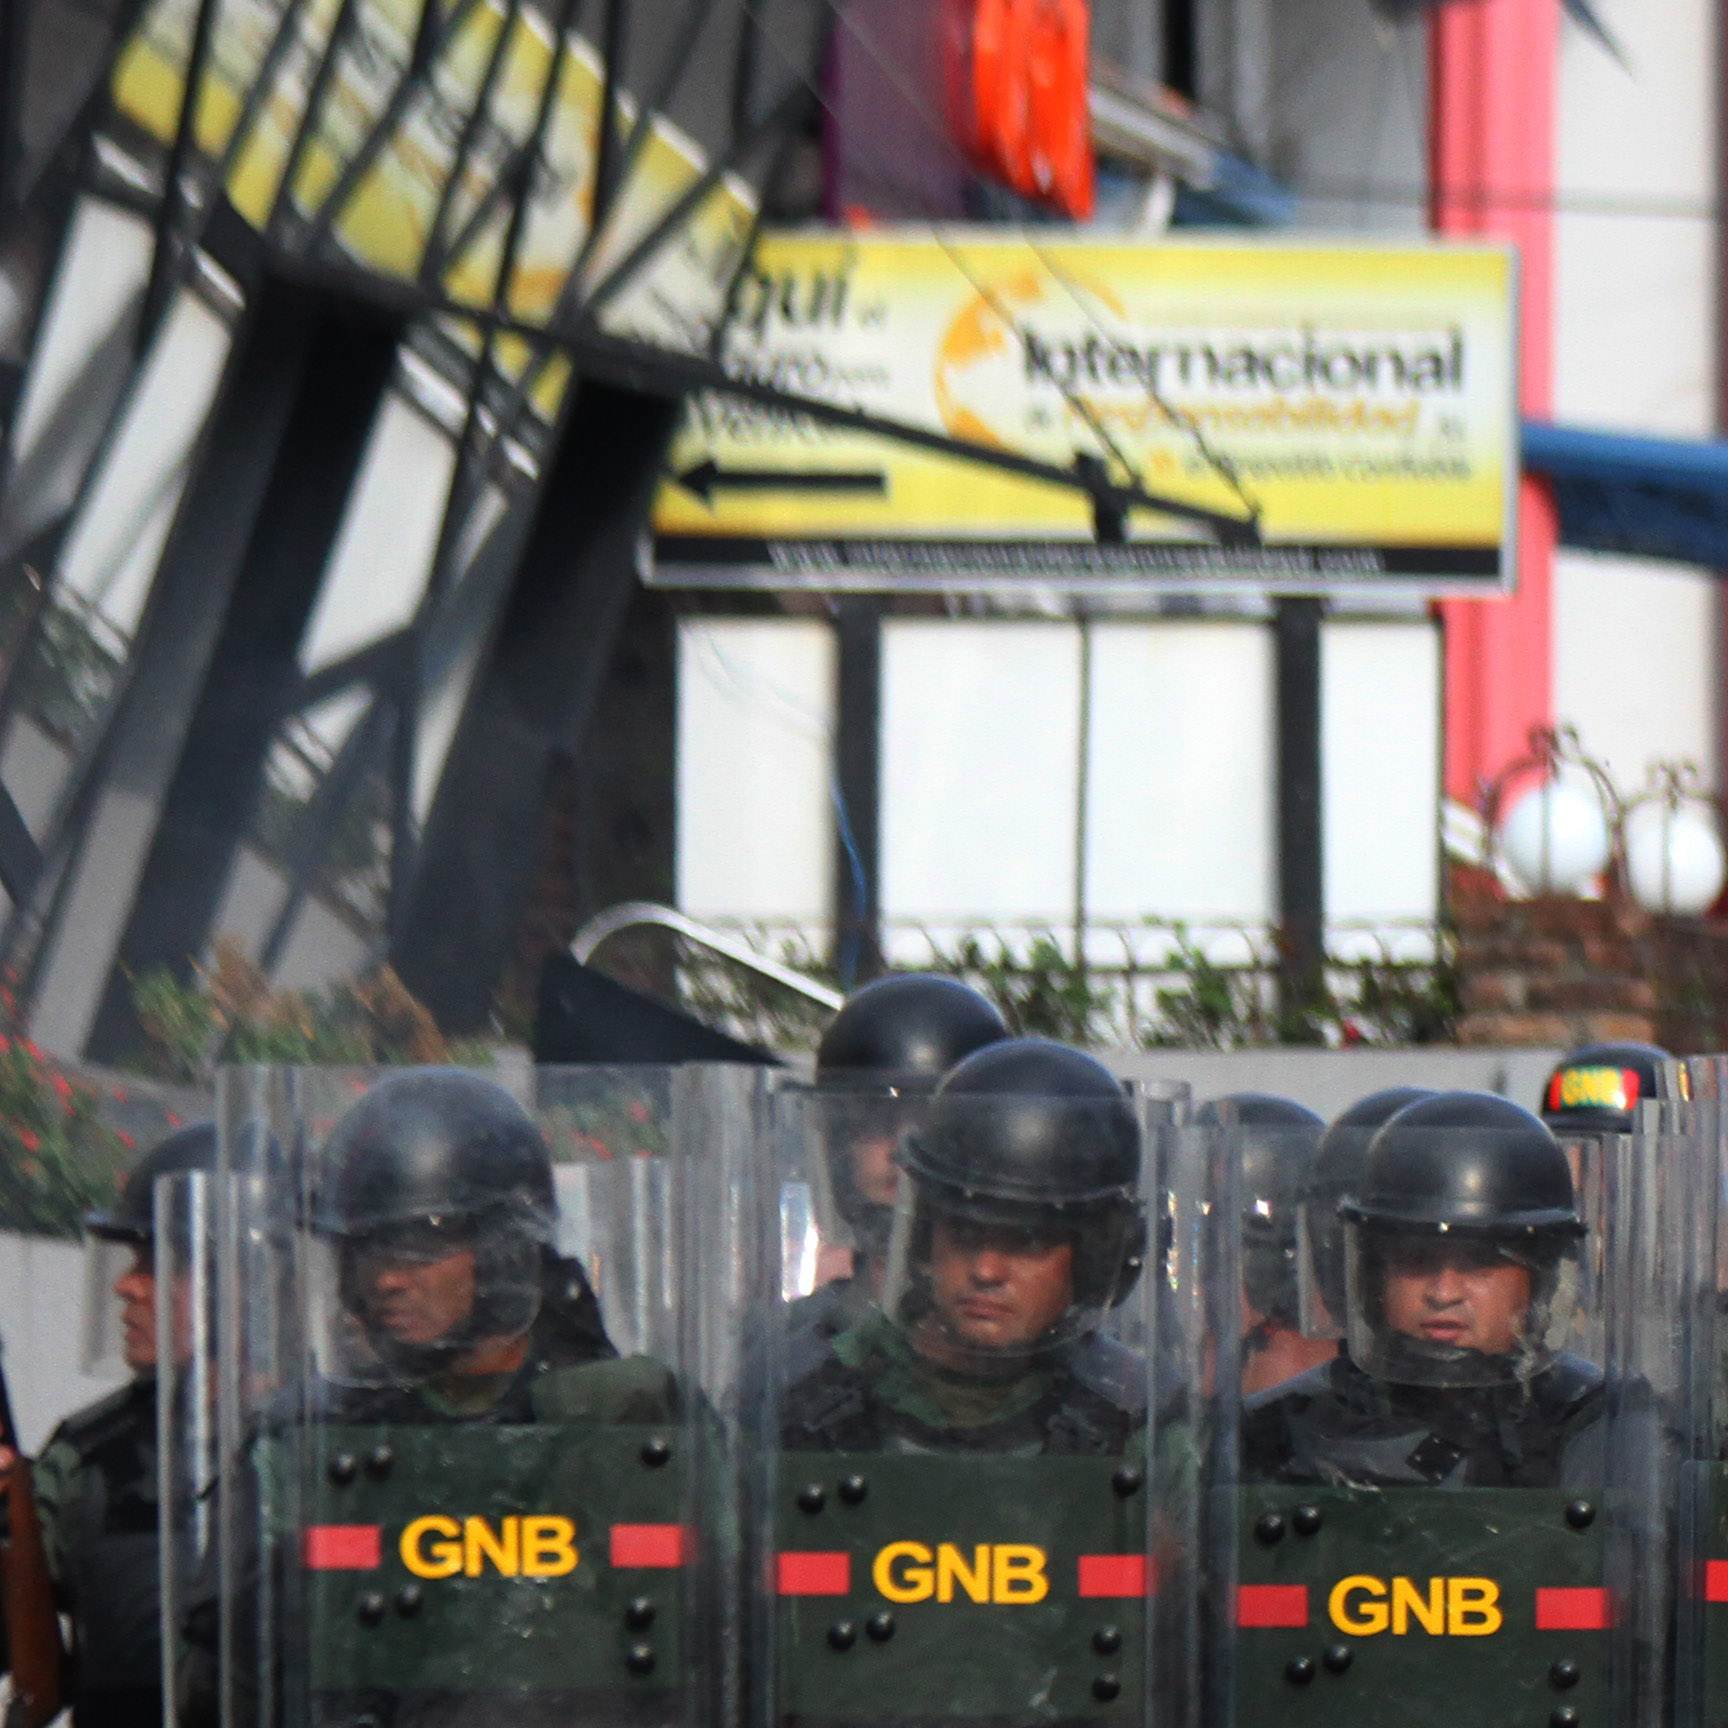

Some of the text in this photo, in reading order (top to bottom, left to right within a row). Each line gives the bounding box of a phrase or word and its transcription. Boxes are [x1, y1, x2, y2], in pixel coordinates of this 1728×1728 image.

[399, 1514, 580, 1579] GNB
[871, 1540, 1051, 1605] GNB
[1327, 1574, 1504, 1637] GNB
